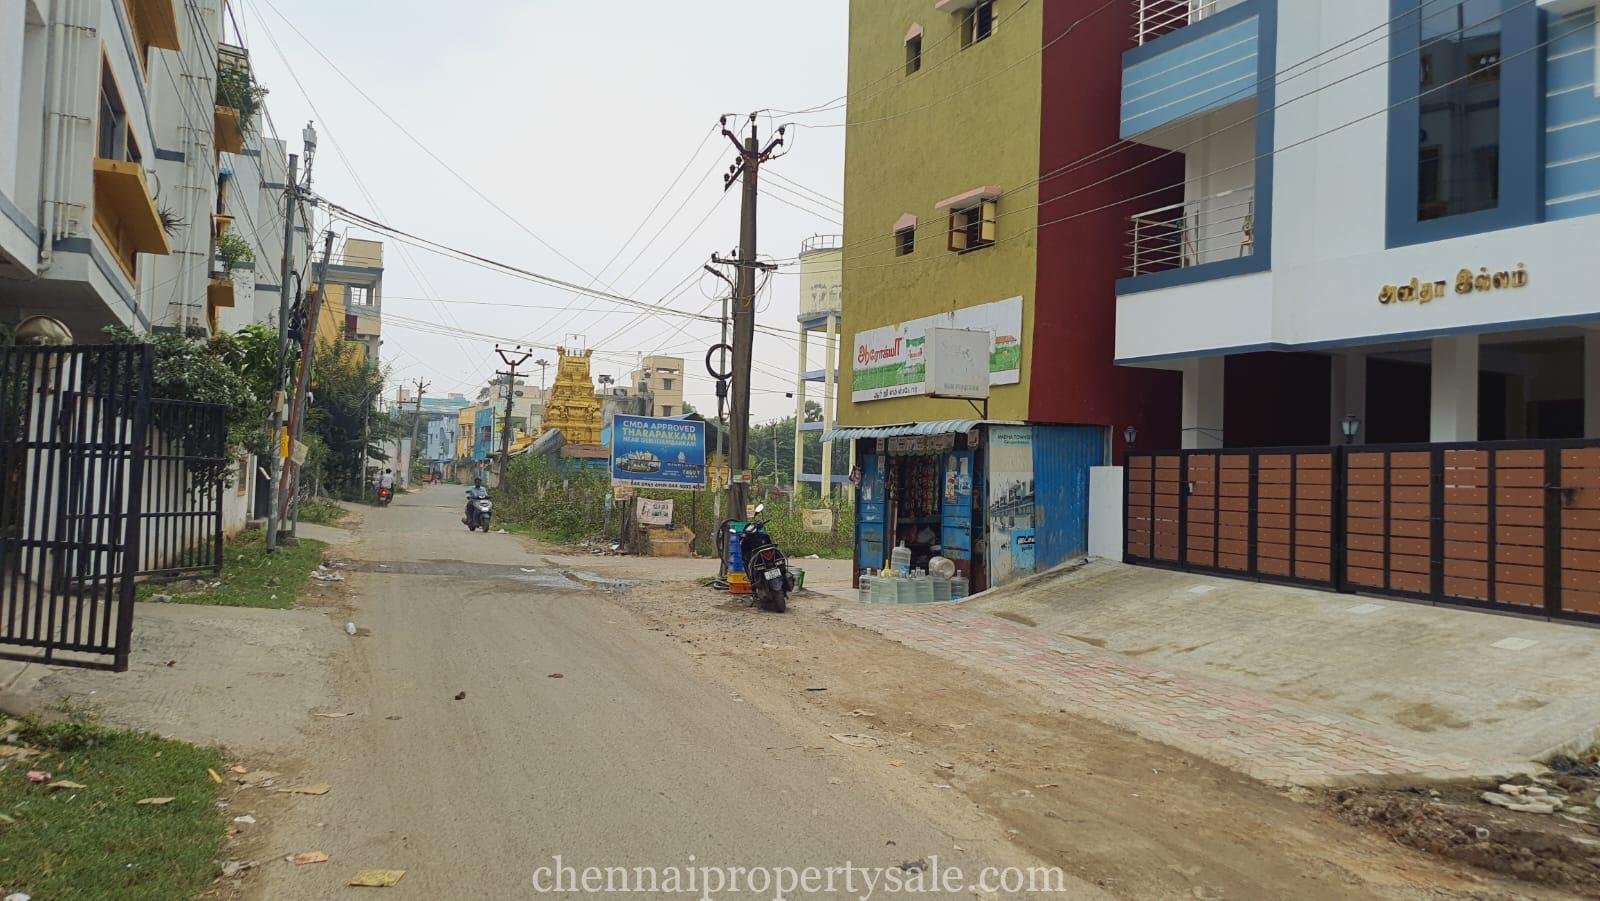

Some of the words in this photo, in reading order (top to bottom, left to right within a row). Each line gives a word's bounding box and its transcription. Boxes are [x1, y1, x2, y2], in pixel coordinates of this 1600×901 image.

[623, 420, 649, 429] CMDA
[650, 422, 696, 433] APPROVED
[623, 427, 697, 441] THARAPAKKAM
